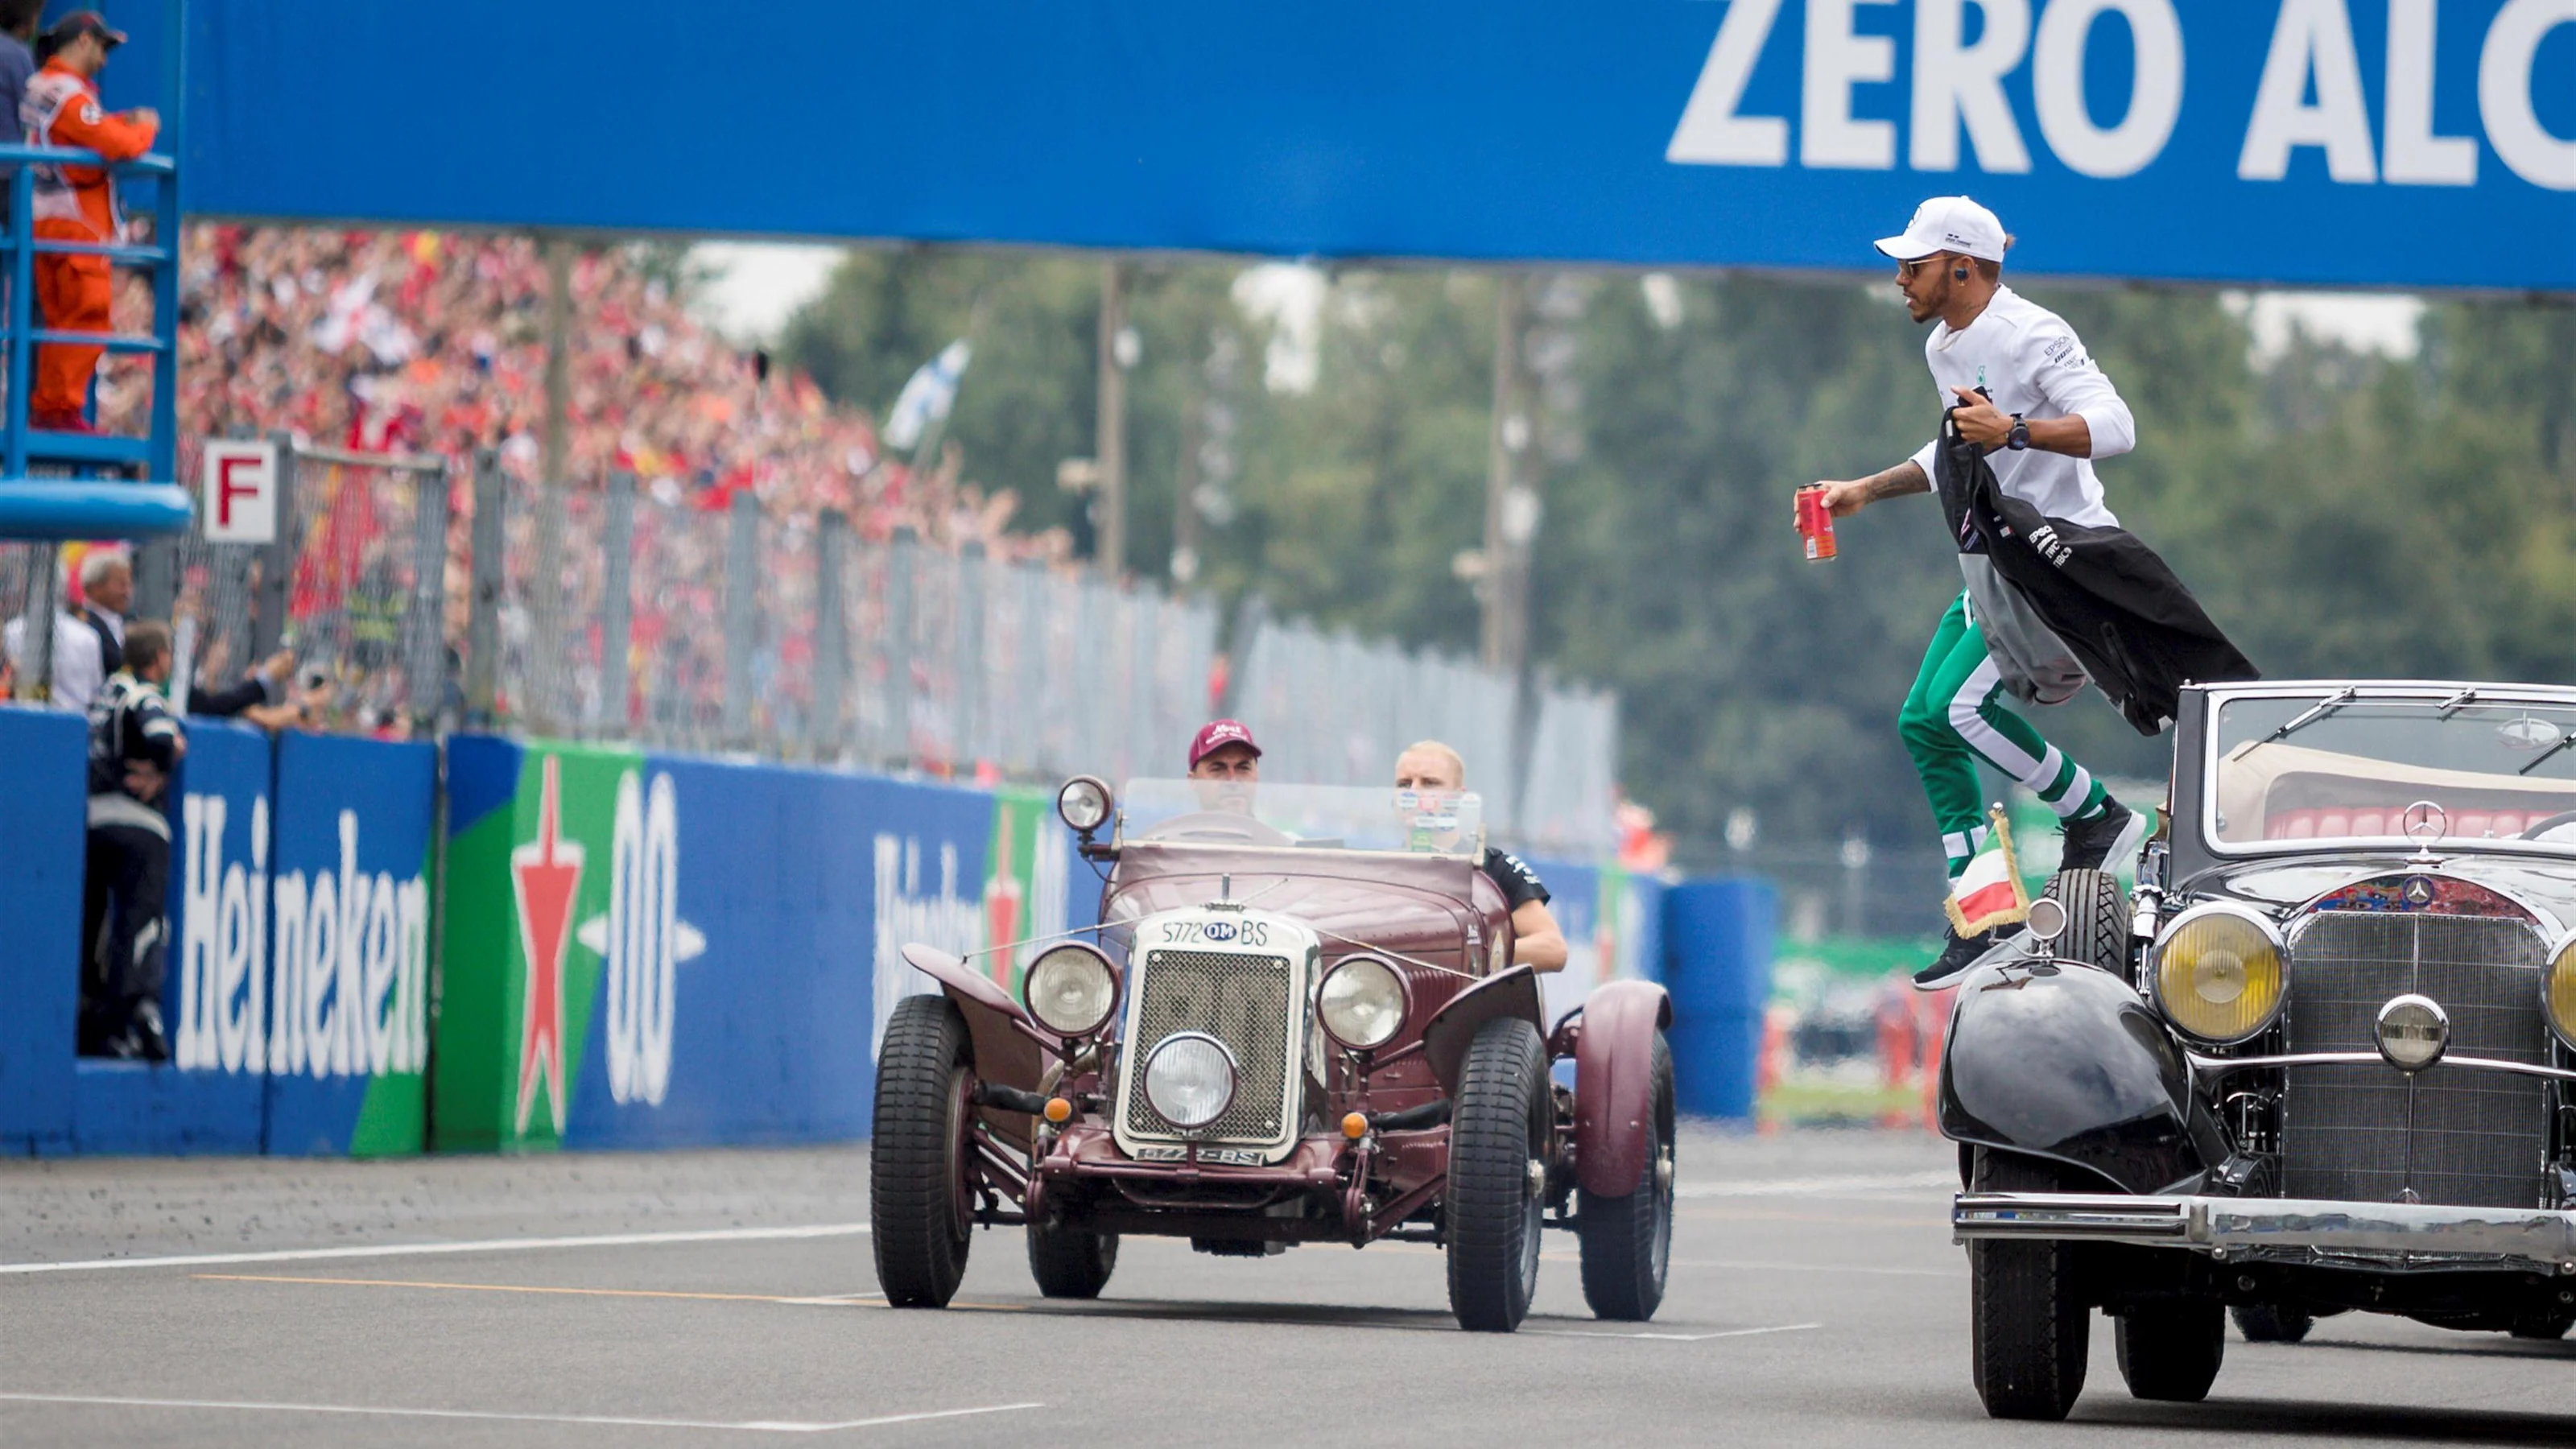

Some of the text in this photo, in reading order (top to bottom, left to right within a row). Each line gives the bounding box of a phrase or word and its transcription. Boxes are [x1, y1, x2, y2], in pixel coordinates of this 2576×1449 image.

[1664, 0, 2186, 179] ZERO
[217, 455, 262, 529] F
[2029, 525, 2054, 544] EPSO
[175, 792, 429, 1080] Heineken
[1162, 920, 1269, 947] 5772 OM BS
